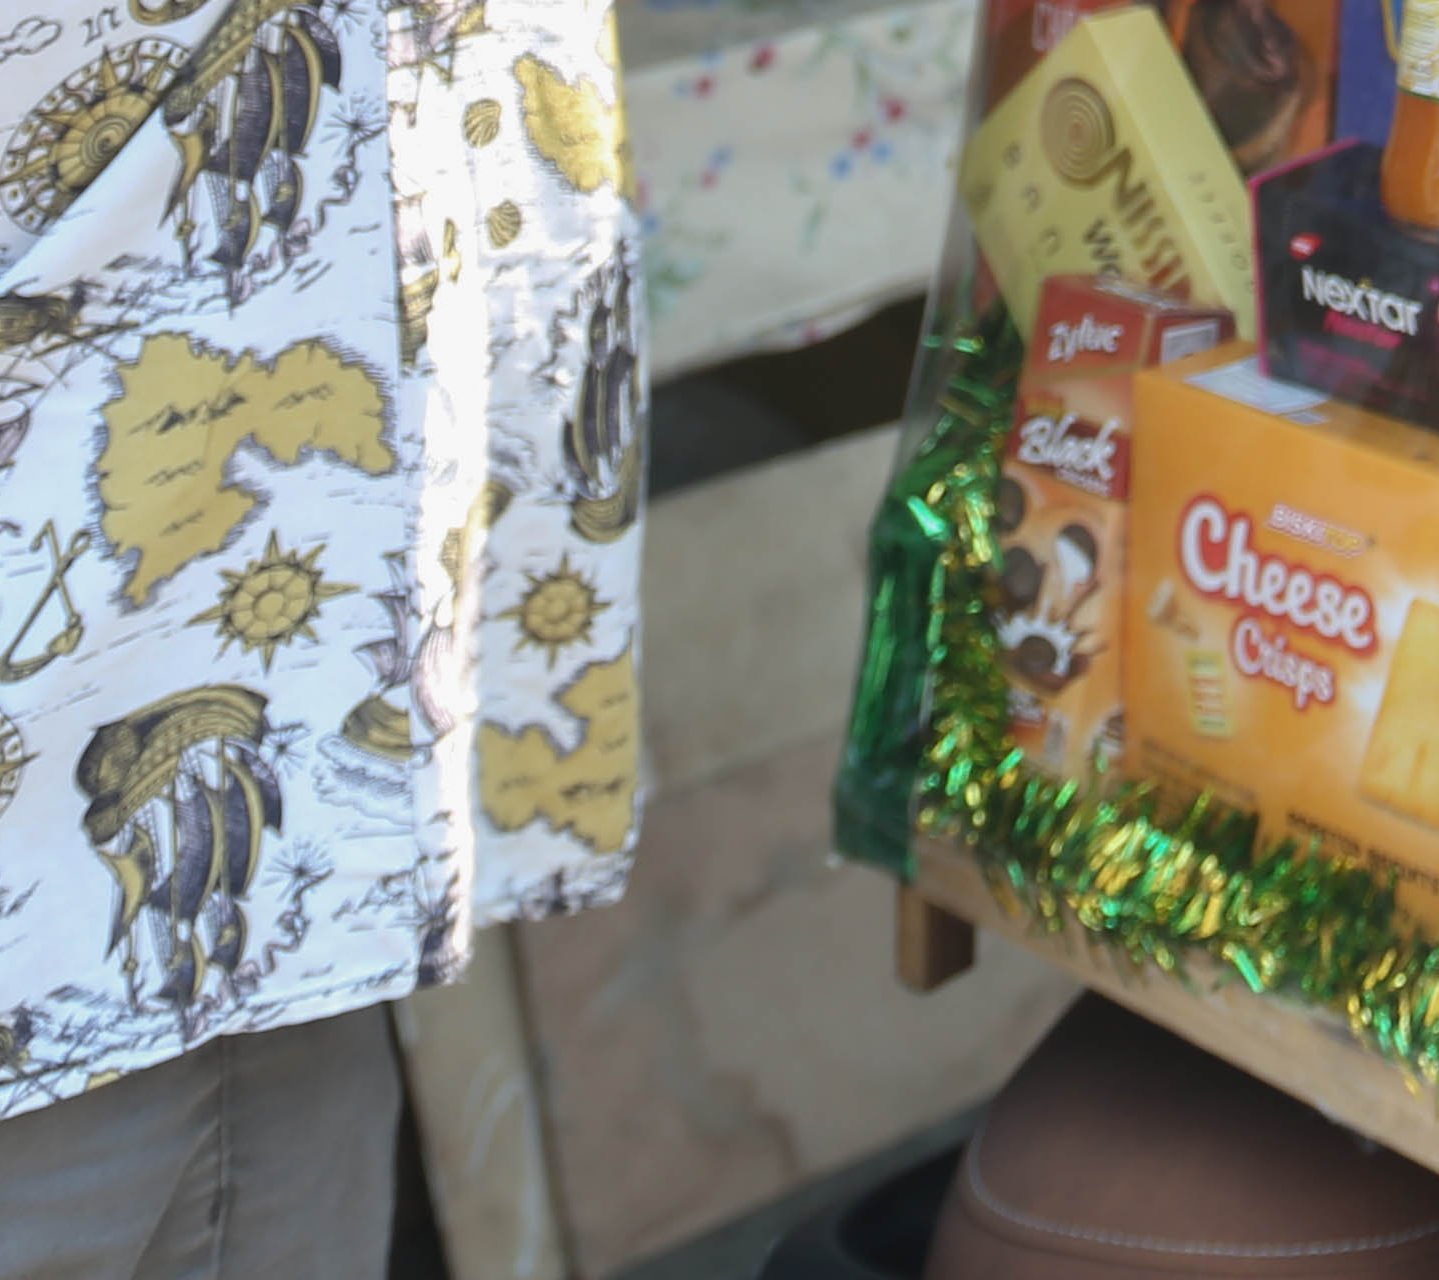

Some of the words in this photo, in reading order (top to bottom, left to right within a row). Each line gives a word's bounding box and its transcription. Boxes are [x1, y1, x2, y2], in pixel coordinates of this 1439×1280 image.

[1017, 411, 1122, 481] Black
[1180, 498, 1374, 650] Cheese
[1233, 617, 1335, 710] Crisps
